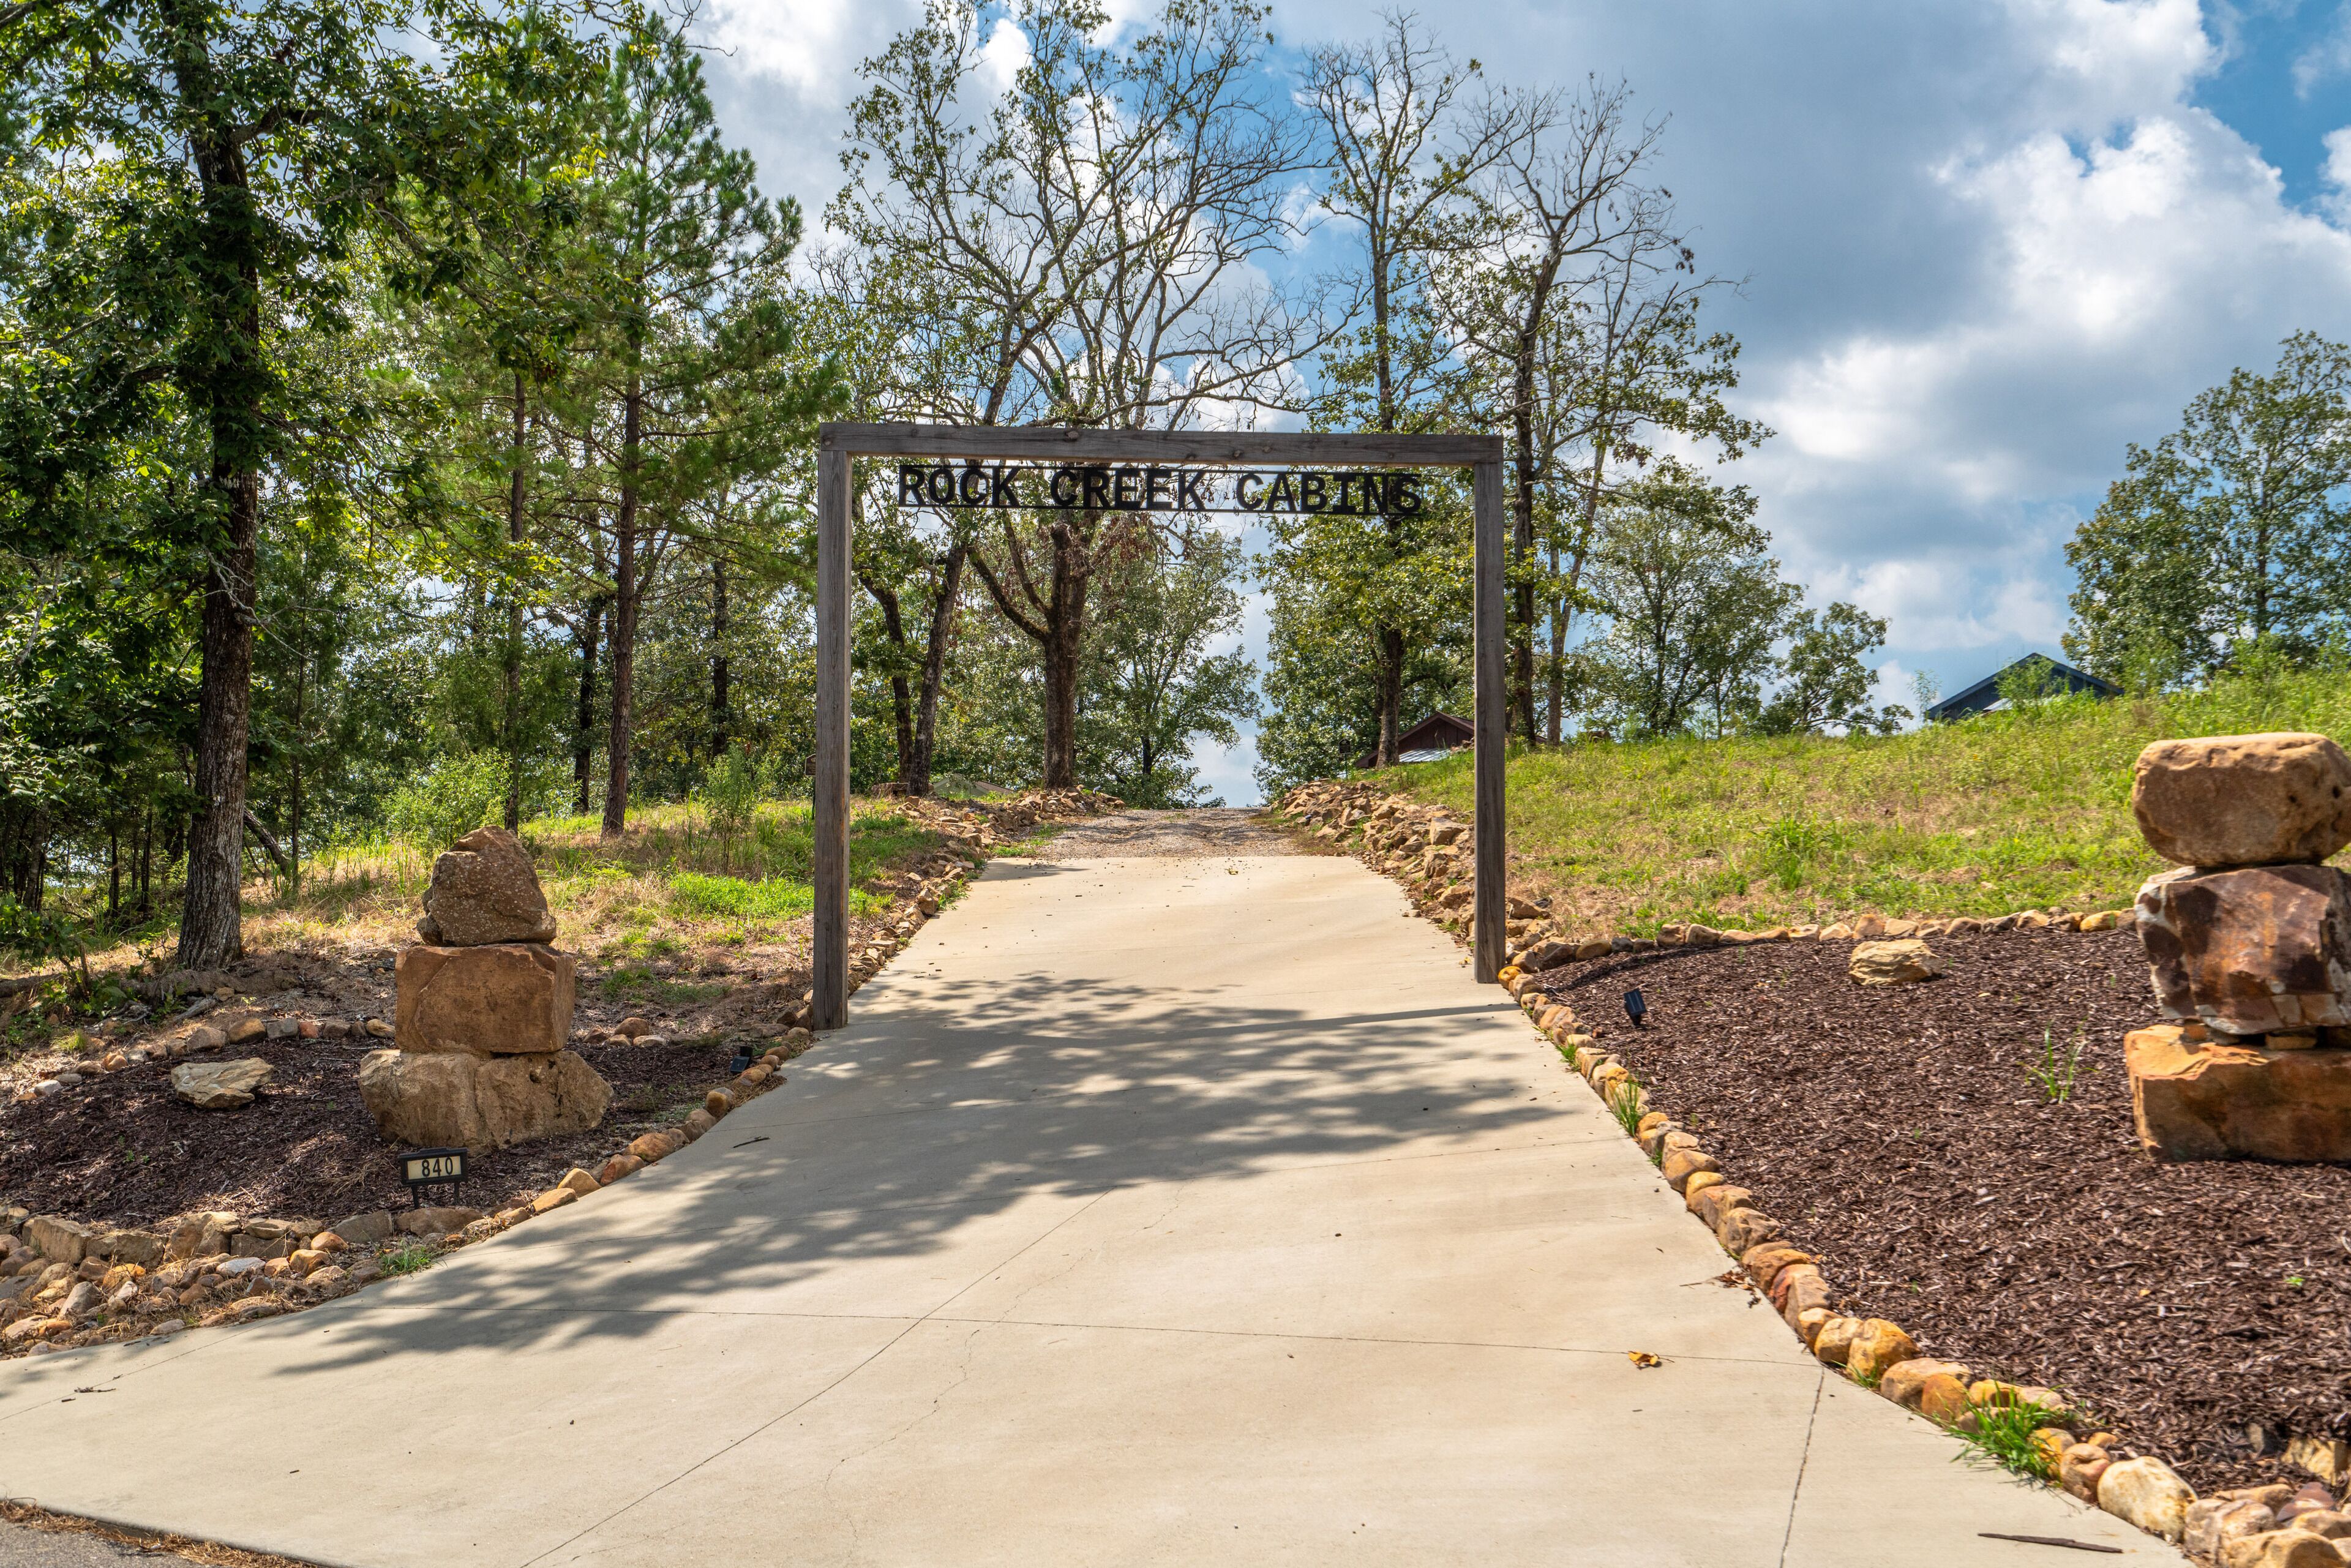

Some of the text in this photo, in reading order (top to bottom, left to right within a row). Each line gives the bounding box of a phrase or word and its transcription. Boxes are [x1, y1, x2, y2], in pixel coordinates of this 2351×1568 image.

[899, 466, 1422, 514] ROCK CREEK CABINS
[422, 1157, 453, 1176] 840
